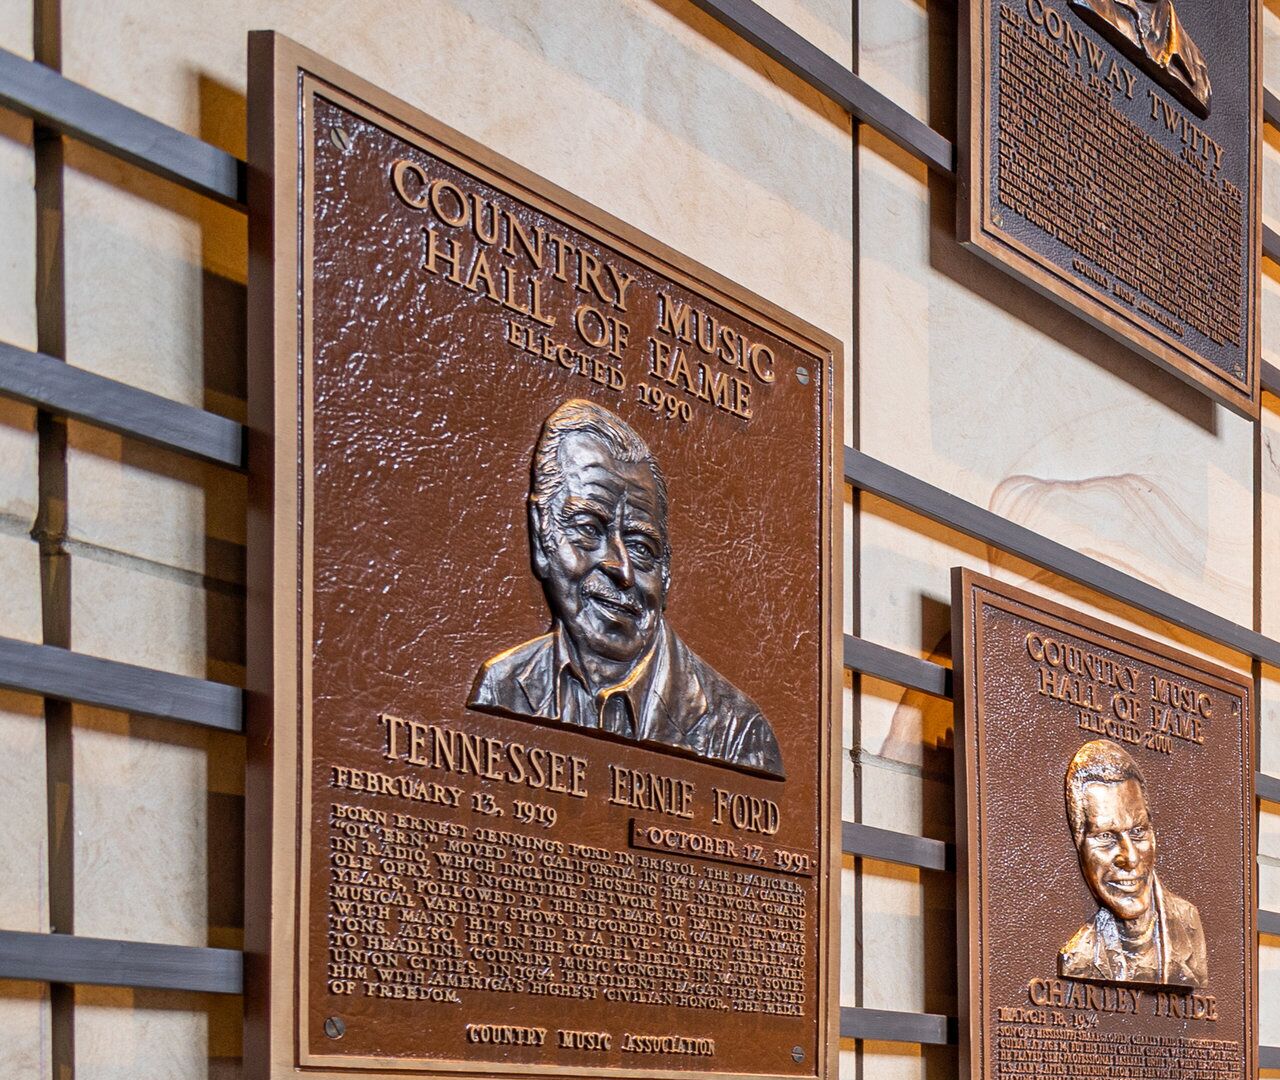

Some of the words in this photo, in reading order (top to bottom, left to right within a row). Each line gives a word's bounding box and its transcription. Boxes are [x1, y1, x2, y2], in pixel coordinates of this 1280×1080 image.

[1027, 0, 1137, 99] CONWAY
[1147, 90, 1225, 170] TWITTY
[392, 160, 635, 311] COUNTRY
[660, 291, 776, 384] MUSIC
[424, 226, 556, 327] HALL
[577, 305, 631, 359] OF
[649, 337, 754, 420] FAME
[509, 321, 627, 392] ELECTED
[638, 382, 694, 424] 1990
[1025, 631, 1141, 694] COUNTRY
[1150, 675, 1213, 718] MUSIC
[1039, 667, 1103, 712] HALL
[1112, 692, 1142, 724] OF
[1150, 705, 1205, 745] FAME
[1078, 710, 1142, 744] ELECTED
[332, 766, 464, 807] FEBRUARY
[472, 793, 504, 817] 13,
[513, 799, 558, 828] 1919
[381, 713, 588, 798] TENNESSEE
[609, 765, 695, 819] ERNIE
[712, 787, 781, 835] FORD
[331, 836, 356, 852] IN
[434, 851, 496, 873] WHICH
[501, 862, 585, 886] INCLUDED
[590, 874, 657, 897] HOSTING
[661, 885, 689, 901] THE
[695, 891, 761, 913] NETWORK
[332, 803, 387, 826] BORN
[394, 813, 468, 838] ERNEST
[473, 827, 565, 854] JENNINGS
[569, 843, 611, 861] FORD
[615, 850, 635, 865] IN
[704, 866, 730, 881] THE
[445, 839, 506, 861] MOVED
[512, 850, 535, 864] TO
[539, 854, 637, 880] CALIFORNIA
[641, 869, 660, 883] IN
[700, 879, 742, 897] AFTER
[649, 826, 739, 857] OCTOBER
[774, 849, 811, 872] 1991
[330, 979, 356, 996] OF
[1028, 977, 1144, 1014] CHARLEY
[1155, 992, 1218, 1022] PRIDE
[466, 1023, 548, 1047] COUNTRY
[557, 1029, 612, 1051] MUSIC
[622, 1033, 716, 1056] ASSOCIATION
